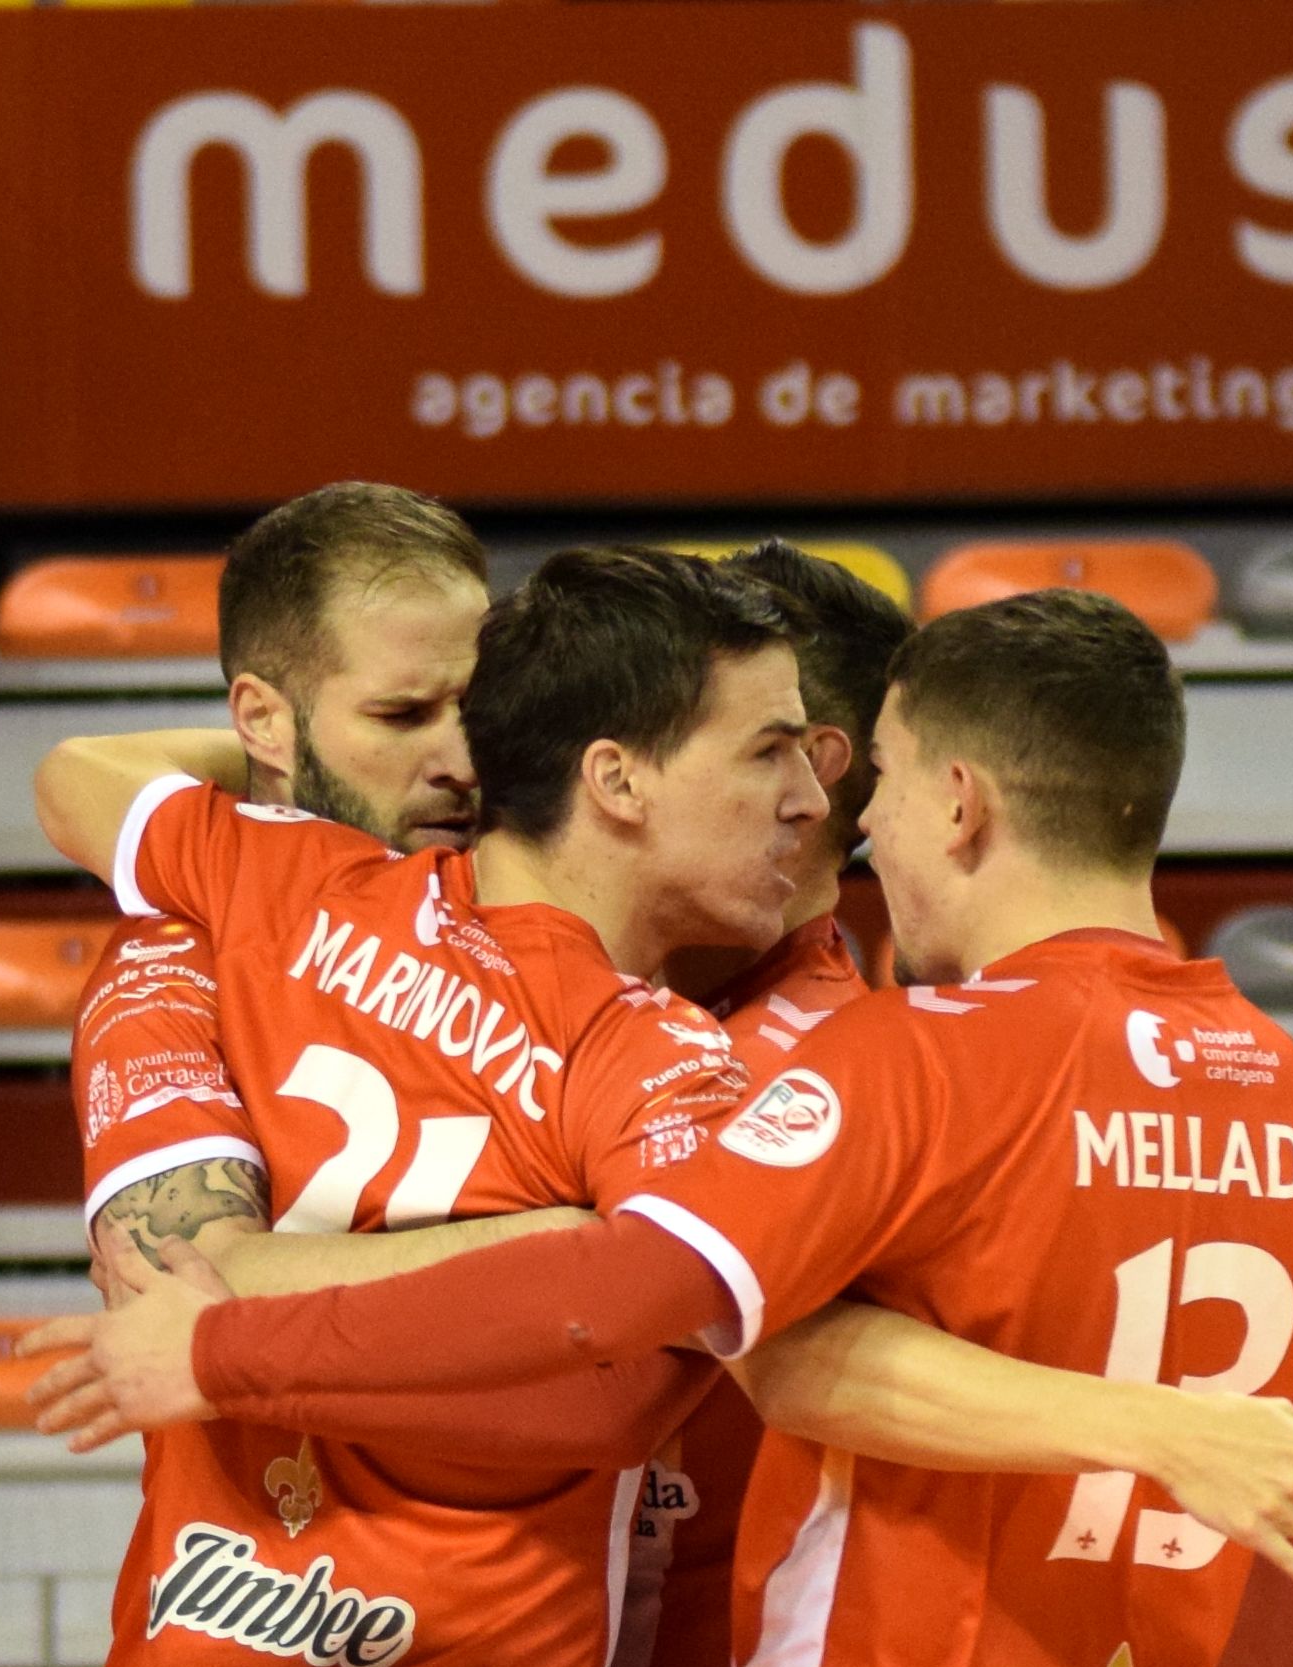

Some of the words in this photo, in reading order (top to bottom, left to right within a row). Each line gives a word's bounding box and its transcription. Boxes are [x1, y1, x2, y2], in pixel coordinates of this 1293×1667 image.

[412, 360, 735, 438] agencia
[759, 360, 860, 428] de
[144, 963, 218, 992] Cartage
[289, 909, 564, 1122] MARINOVIC
[641, 1060, 701, 1092] Puerto
